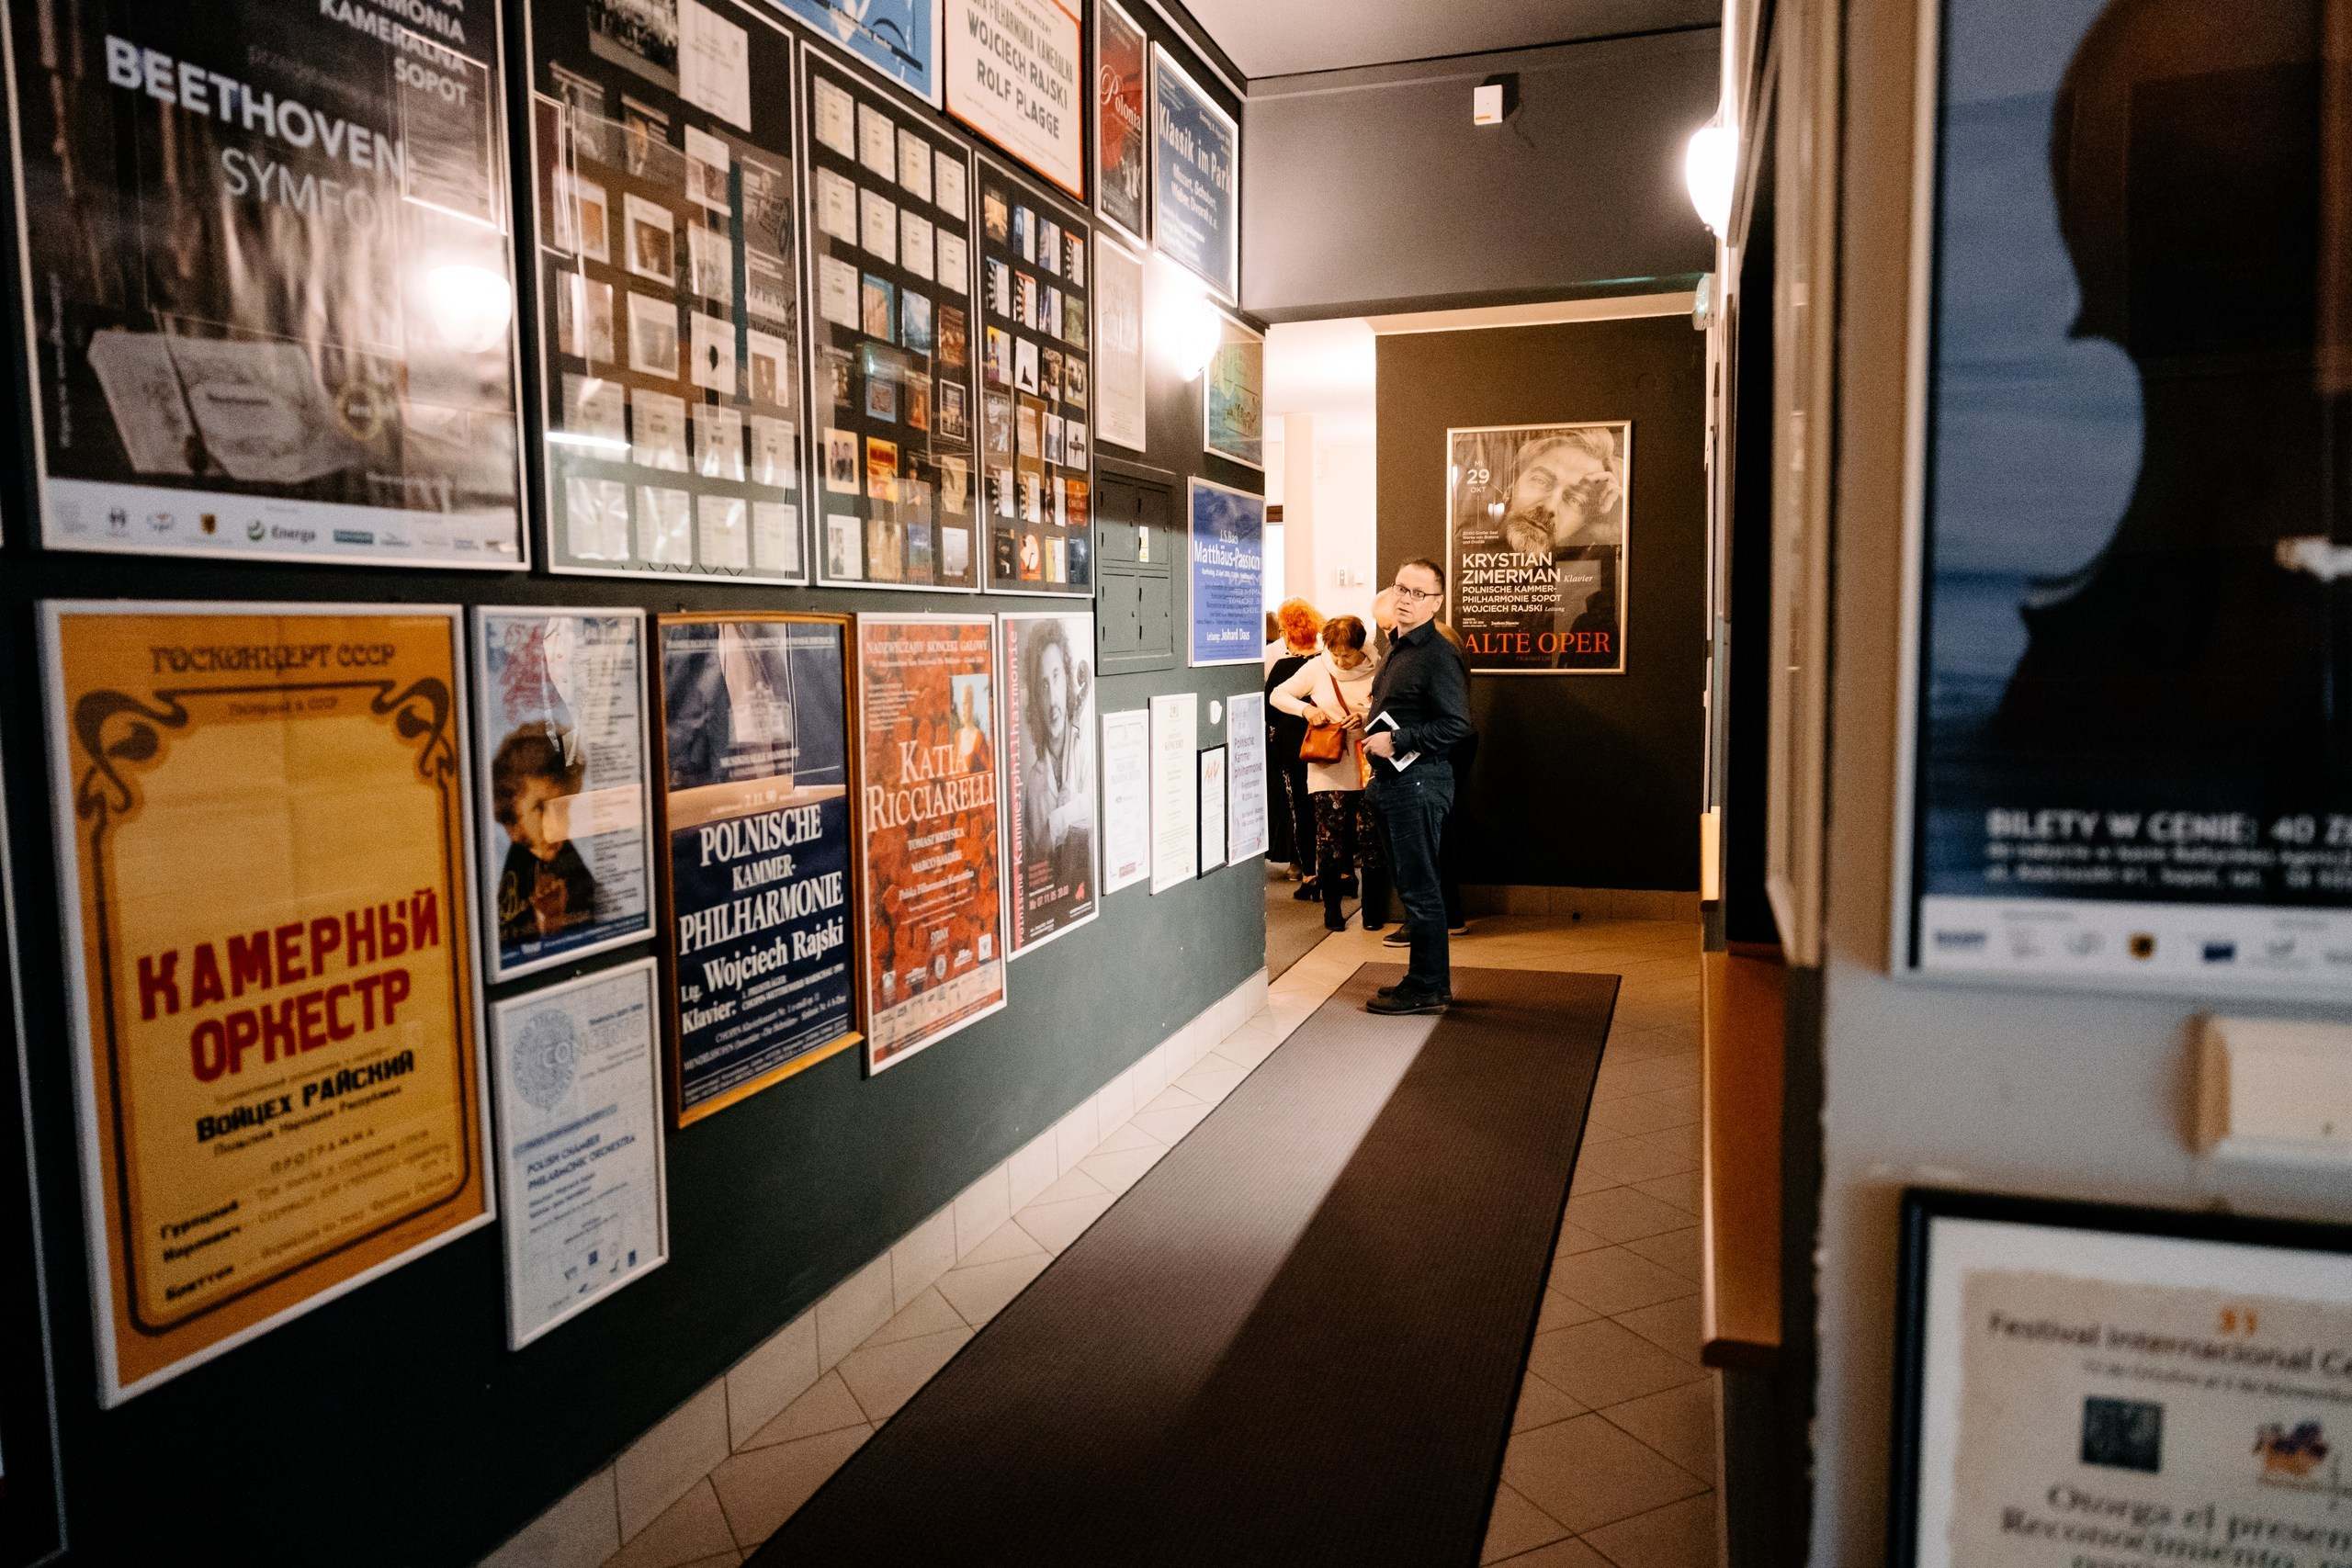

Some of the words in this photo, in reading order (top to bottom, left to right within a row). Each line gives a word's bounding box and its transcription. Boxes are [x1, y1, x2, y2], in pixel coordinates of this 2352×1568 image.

[393, 56, 469, 107] SOPOT
[967, 7, 1026, 78] WOJCIECH
[1030, 61, 1068, 111] RAJSKI
[105, 34, 407, 178] BEETHOVEN
[977, 58, 1012, 102] ROLF
[1016, 87, 1060, 141] PLAGGE
[1101, 64, 1141, 132] Polonia
[1159, 102, 1194, 164] Klassik
[1198, 138, 1209, 176] im
[1211, 151, 1232, 197] Park
[1466, 468, 1490, 485] 29
[270, 524, 317, 543] Energa
[1194, 540, 1261, 570] Matthäus-Passion
[1462, 569, 1561, 584] ZIMERMAN
[1564, 574, 1593, 582] Klavier
[1463, 552, 1552, 568] KRYSTIAN
[1463, 585, 1512, 594] POLNISCHE
[1514, 585, 1556, 593] KAMMER-
[1463, 595, 1529, 604] PHILHARMONIE
[1532, 594, 1562, 603] SOPOT
[1463, 604, 1509, 613] WOJCIECH
[1511, 604, 1543, 613] RAJSKI
[150, 643, 332, 674] ГОСКОНЦЕРТ
[336, 642, 396, 669] СССР
[1465, 632, 1531, 654] ALTE
[1538, 632, 1611, 653] OPER
[899, 739, 969, 784] KATIA
[866, 772, 995, 833] RICCIARELLI
[1985, 807, 2101, 842] BILETY
[2107, 810, 2142, 840] W
[2270, 813, 2315, 844] 40
[699, 804, 823, 868] POLNISCHE
[731, 853, 797, 892] KAMMER-
[679, 871, 844, 956] PHILHARMONIE
[137, 886, 439, 1022] КАМЕРНЫЙ
[703, 935, 788, 993] Wojciech
[791, 915, 844, 963] Rajski
[189, 967, 413, 1084] ОРКЕСТР
[681, 999, 737, 1036] Klavier:
[302, 1049, 415, 1109] РАЙСКИЙ
[1987, 1308, 2102, 1348] Festival
[2106, 1327, 2313, 1374] Internacional
[2046, 1483, 2172, 1528] Otorga
[2183, 1503, 2215, 1529] el
